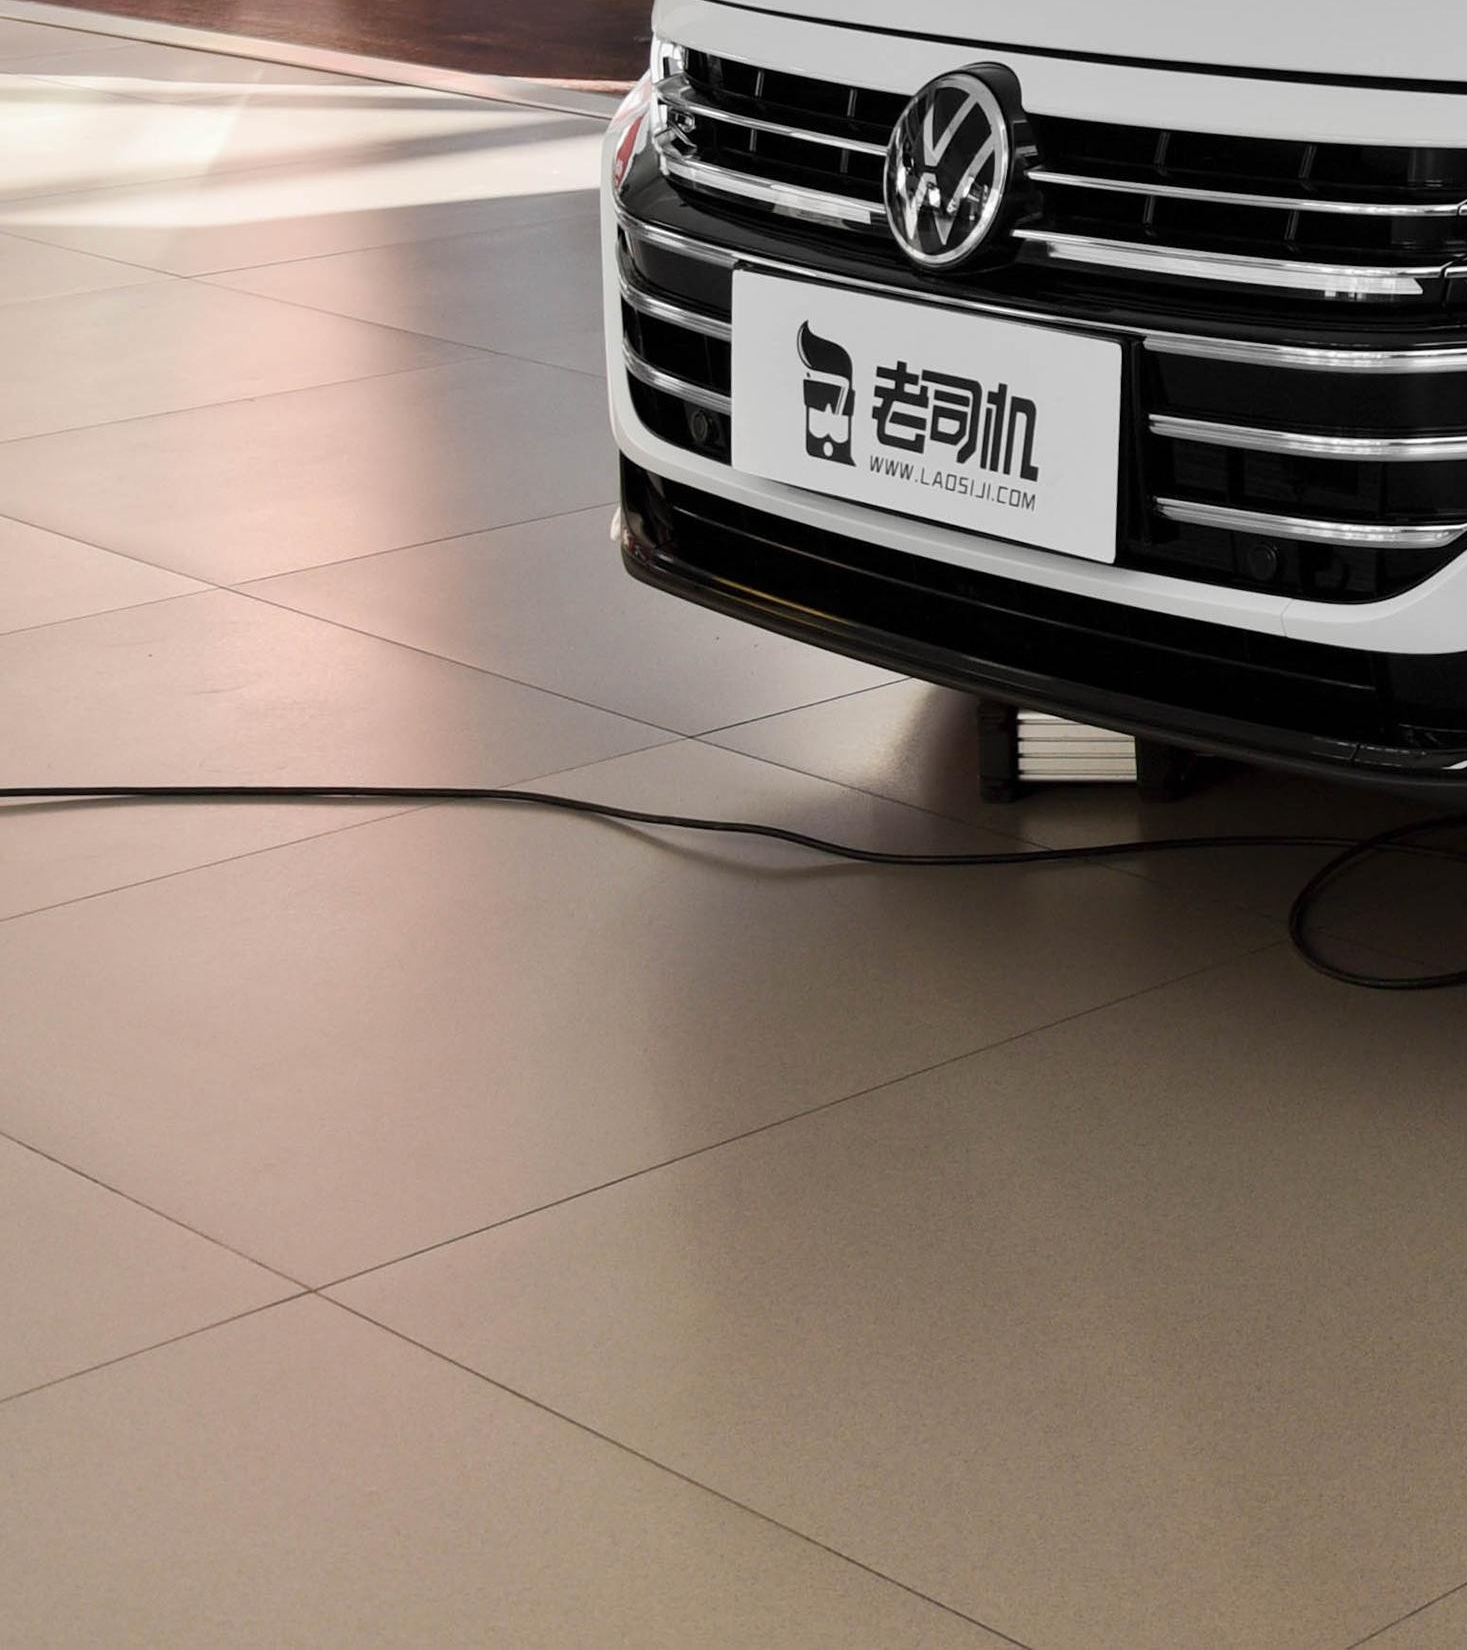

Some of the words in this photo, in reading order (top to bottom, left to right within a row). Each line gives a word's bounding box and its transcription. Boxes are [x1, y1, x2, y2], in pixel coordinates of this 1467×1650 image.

[871, 360, 1039, 483] 老司机
[869, 454, 1037, 512] WWW.LAOSIJI.COM
